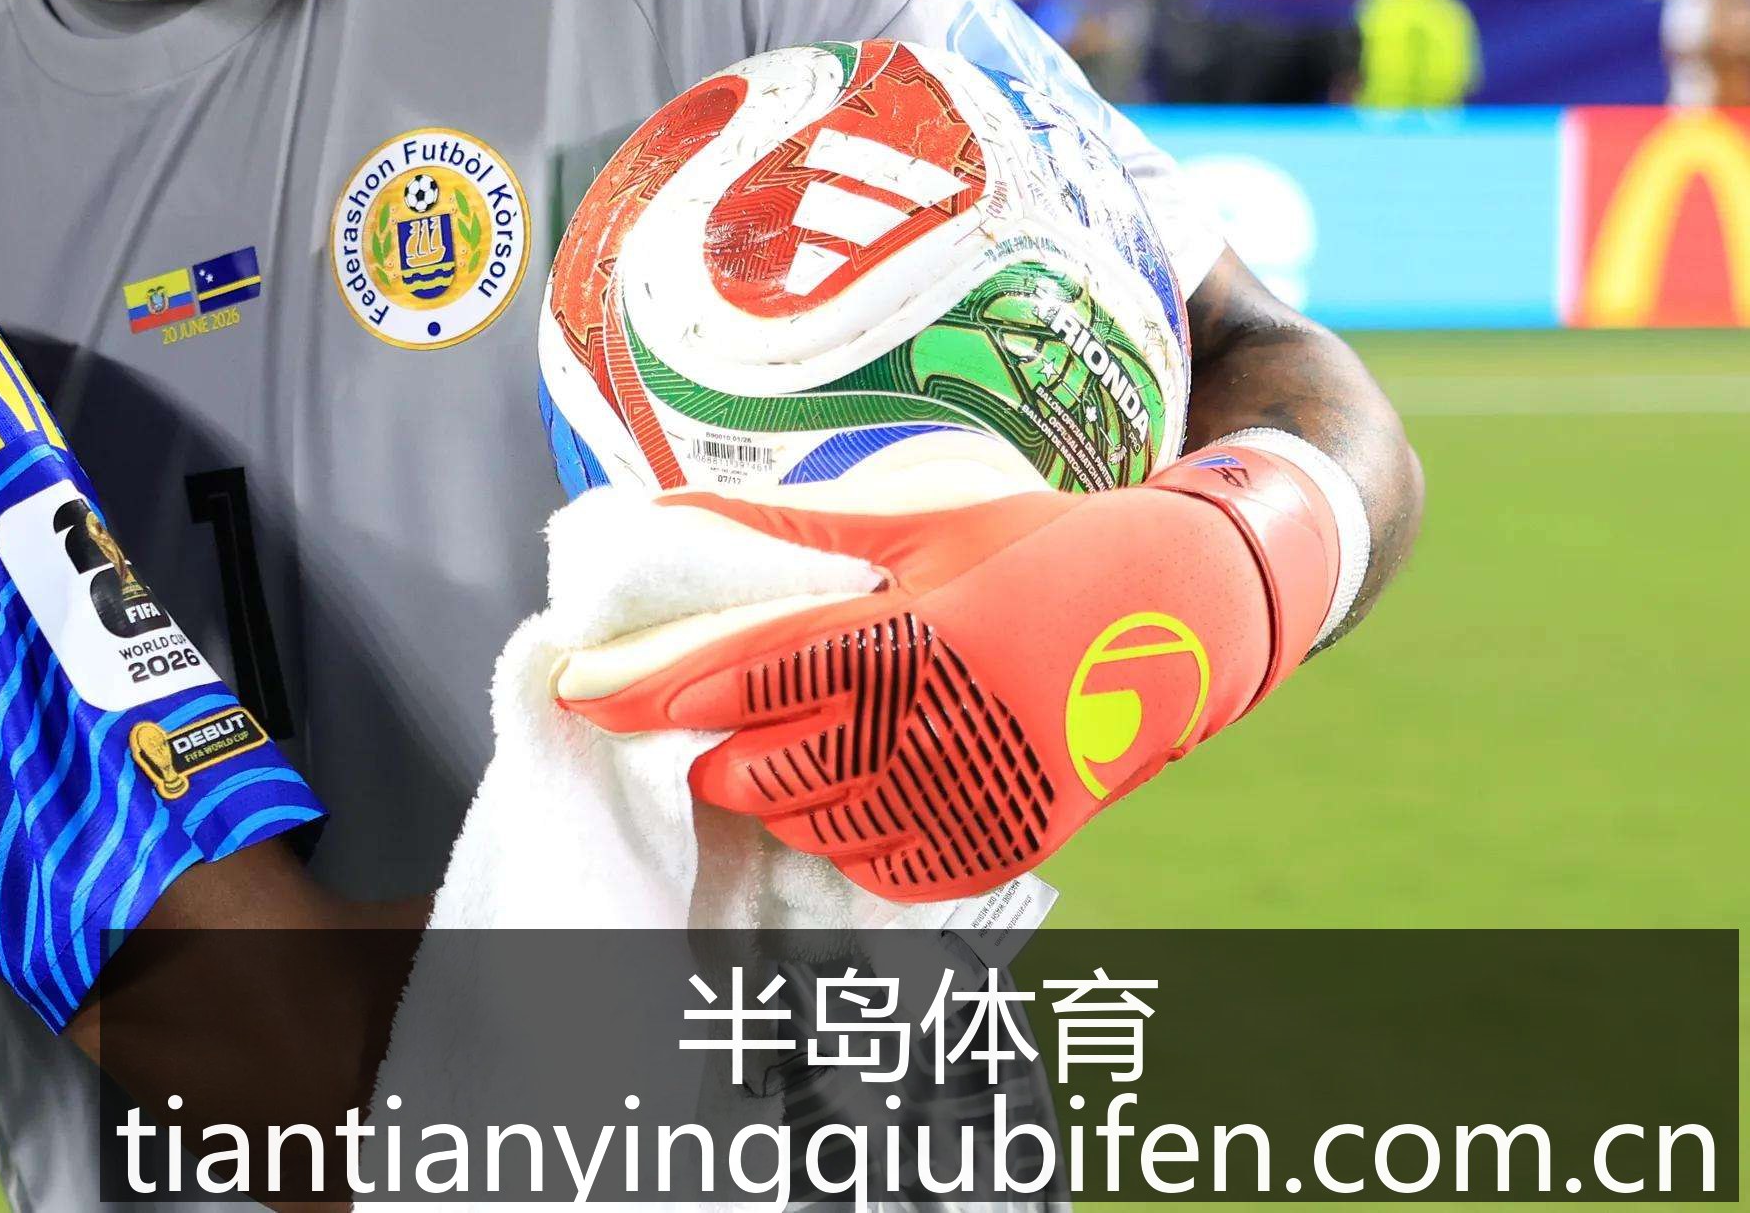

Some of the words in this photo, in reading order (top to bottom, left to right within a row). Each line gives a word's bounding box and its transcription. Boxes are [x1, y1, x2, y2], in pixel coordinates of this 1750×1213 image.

[343, 157, 395, 326] Federashon
[403, 140, 494, 183] Futbòl
[477, 182, 514, 299] Kòrsou
[177, 318, 210, 340] JUNE
[211, 307, 241, 332] 2026
[1021, 404, 1055, 438] BALLON
[1051, 435, 1062, 450] DE
[1060, 446, 1083, 478] MATCH
[1035, 385, 1066, 417] BALÓN
[1062, 413, 1086, 445] OFICIAL
[1084, 441, 1098, 459] DEL
[1094, 455, 1114, 489] PARTIDO
[1048, 416, 1080, 453] OFFICIAL
[1076, 448, 1099, 480] MATCH
[1128, 432, 1141, 453] PRO
[125, 602, 161, 624] FIFA
[118, 634, 169, 661] WORLD
[128, 647, 201, 684] 2026
[172, 713, 246, 755] DEBUT
[184, 748, 205, 763] FIFA
[203, 736, 234, 755] WORLD
[233, 730, 249, 743] CUP
